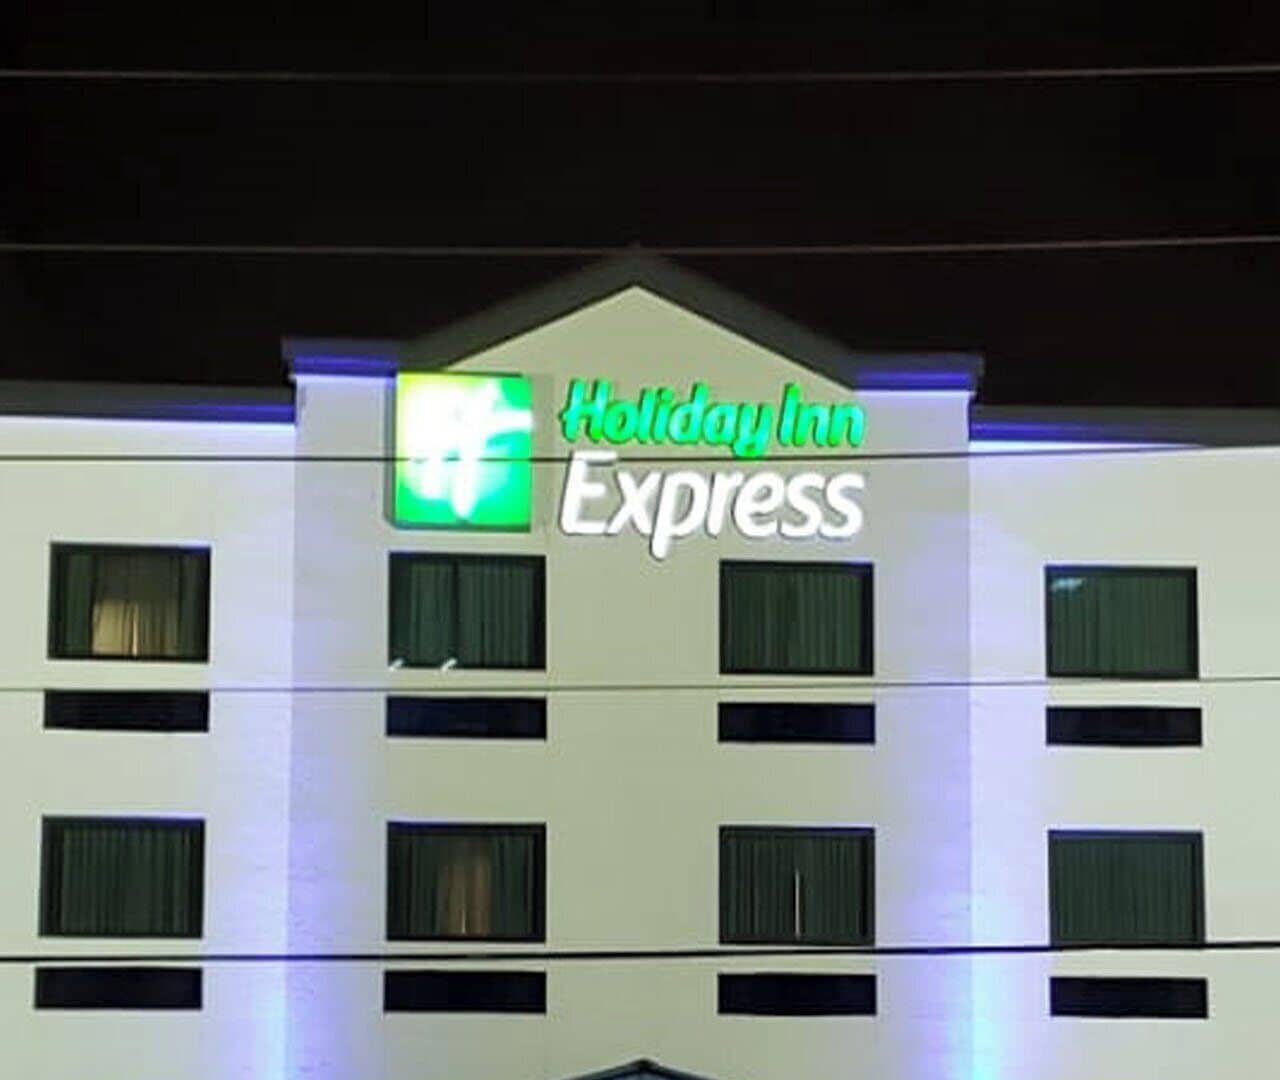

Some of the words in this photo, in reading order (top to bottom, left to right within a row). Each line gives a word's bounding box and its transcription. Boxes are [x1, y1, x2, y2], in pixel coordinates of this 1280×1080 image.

[560, 379, 773, 461] Holiday
[777, 382, 866, 447] Inn
[560, 450, 866, 561] Express
